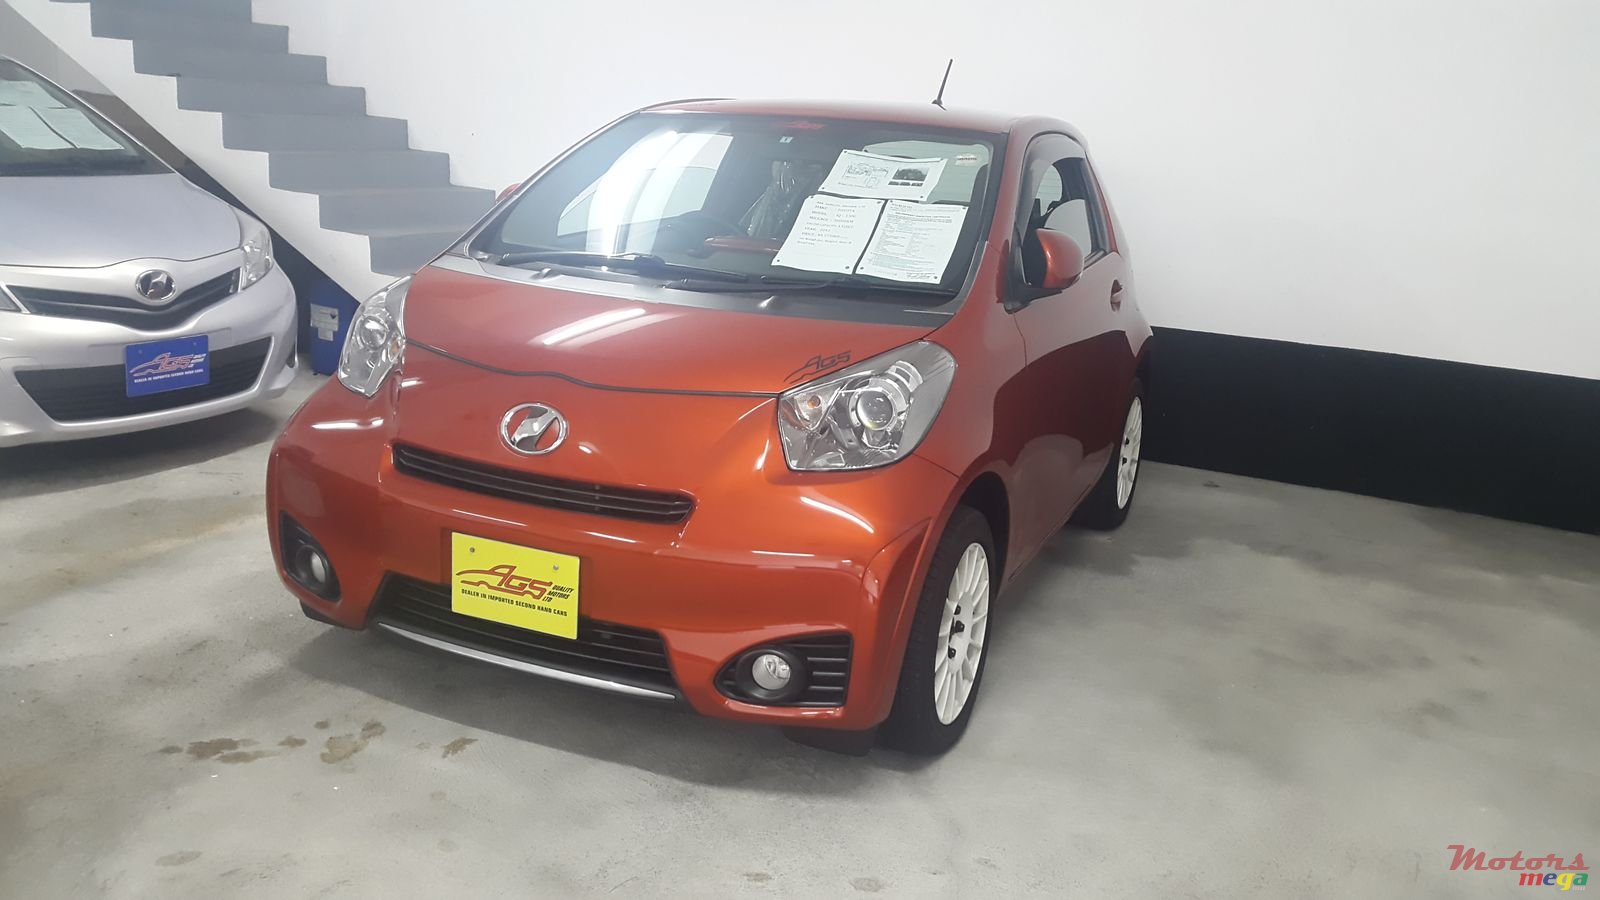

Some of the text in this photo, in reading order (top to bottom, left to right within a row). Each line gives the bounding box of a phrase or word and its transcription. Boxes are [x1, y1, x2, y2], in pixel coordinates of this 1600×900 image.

[797, 350, 851, 374] AGS
[477, 564, 553, 600] AGS
[552, 585, 574, 593] QUALITY
[461, 588, 480, 597] DEALER
[488, 594, 514, 605] IMPORTED
[515, 600, 536, 609] SECOND
[537, 606, 552, 614] HAND
[553, 608, 568, 616] CARS
[547, 591, 571, 600] MOTORS
